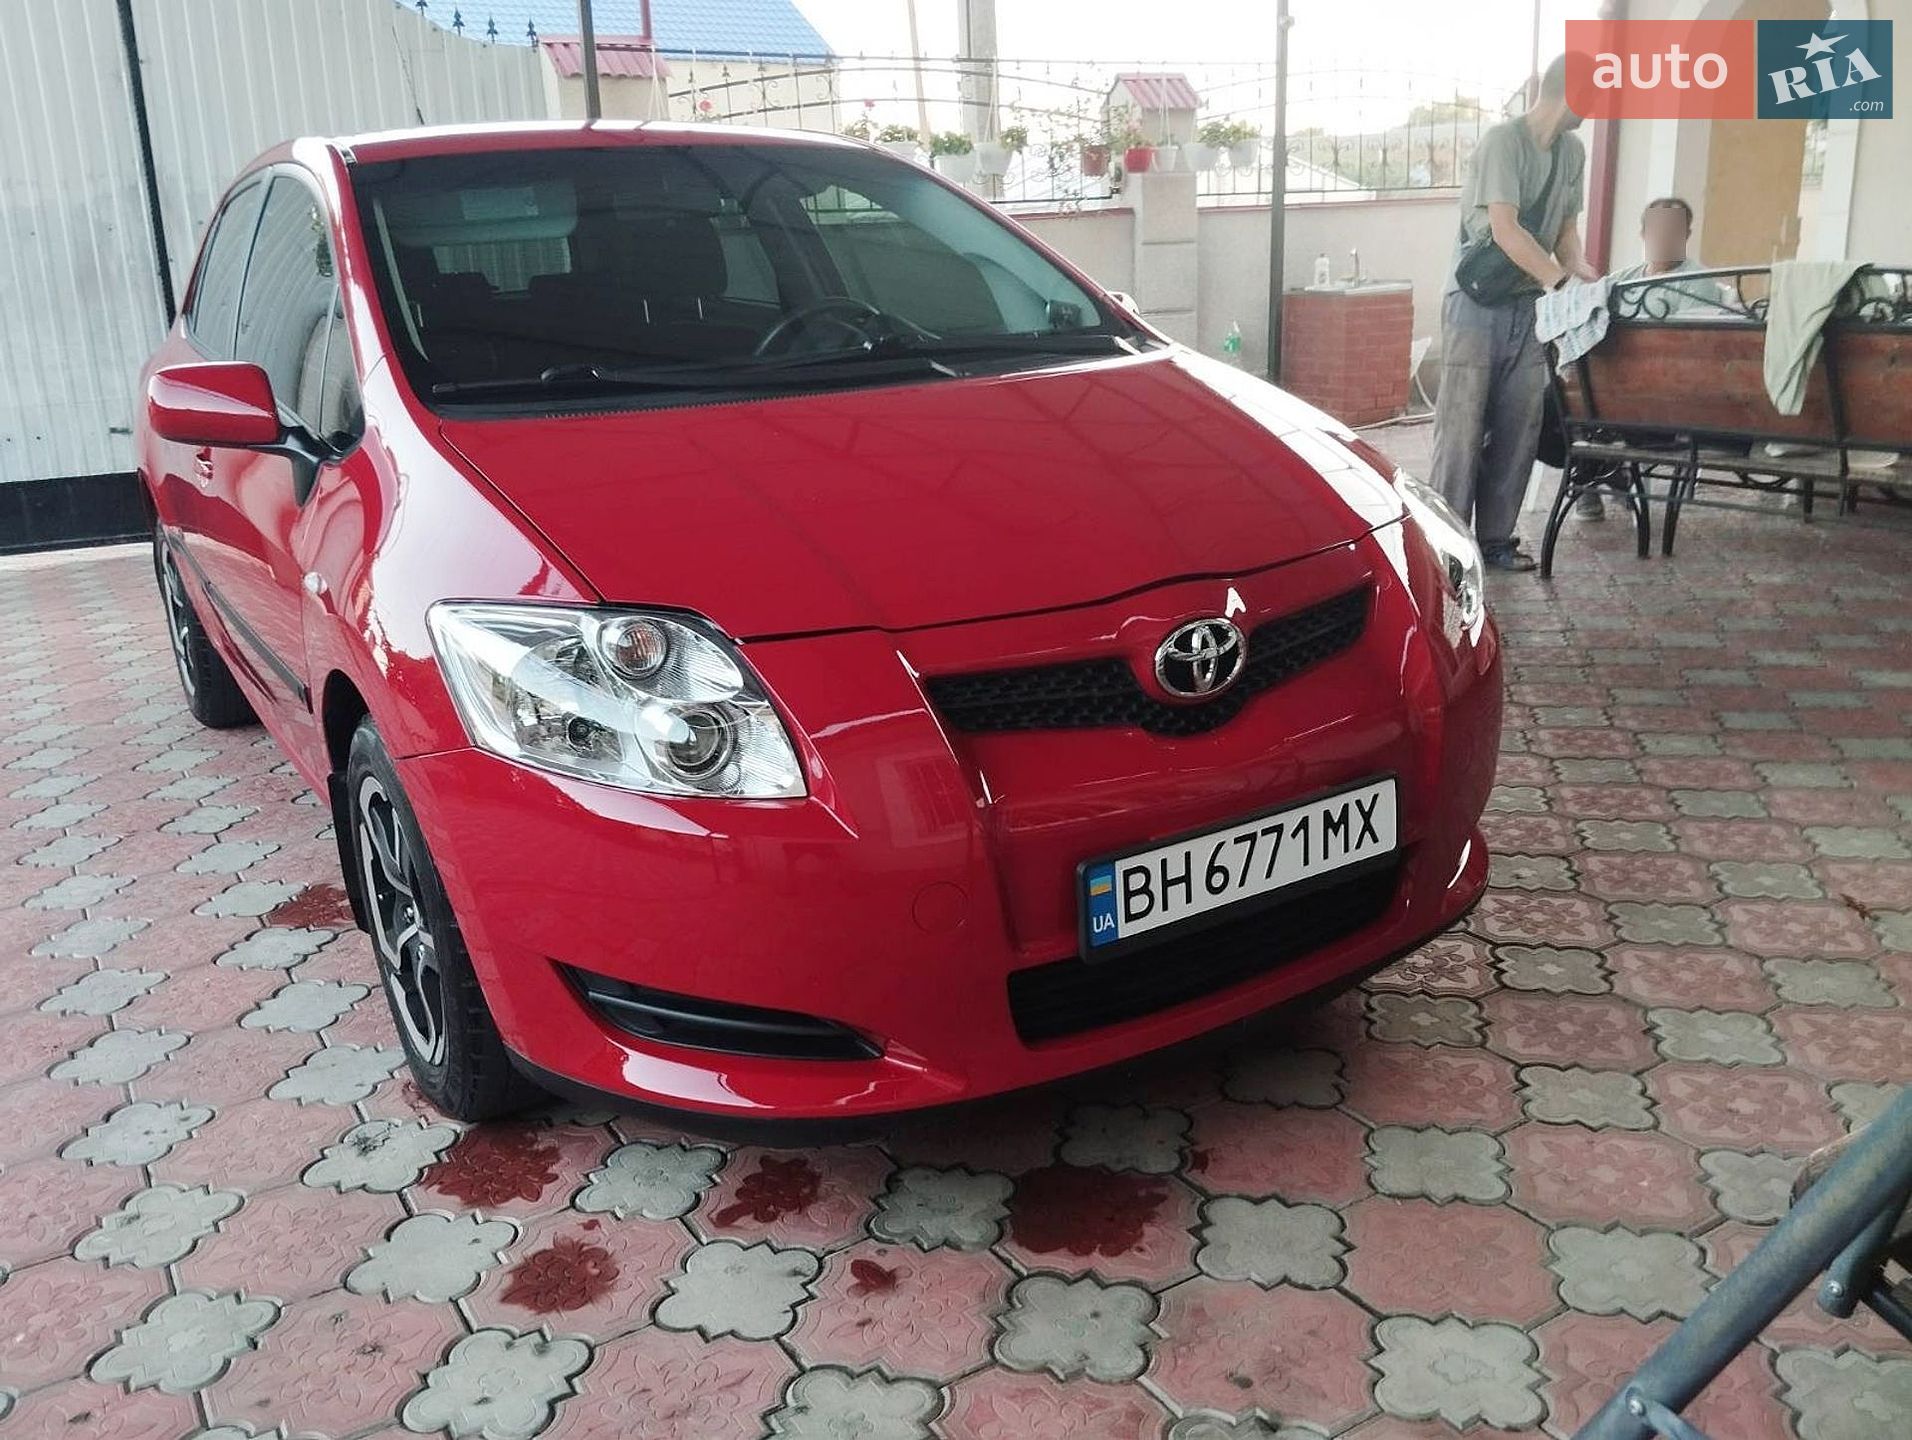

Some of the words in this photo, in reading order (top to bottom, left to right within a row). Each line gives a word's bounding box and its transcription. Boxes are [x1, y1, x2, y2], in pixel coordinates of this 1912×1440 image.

[1122, 851, 1192, 924] BH
[1205, 815, 1310, 895] 6771
[1093, 912, 1115, 933] UA
